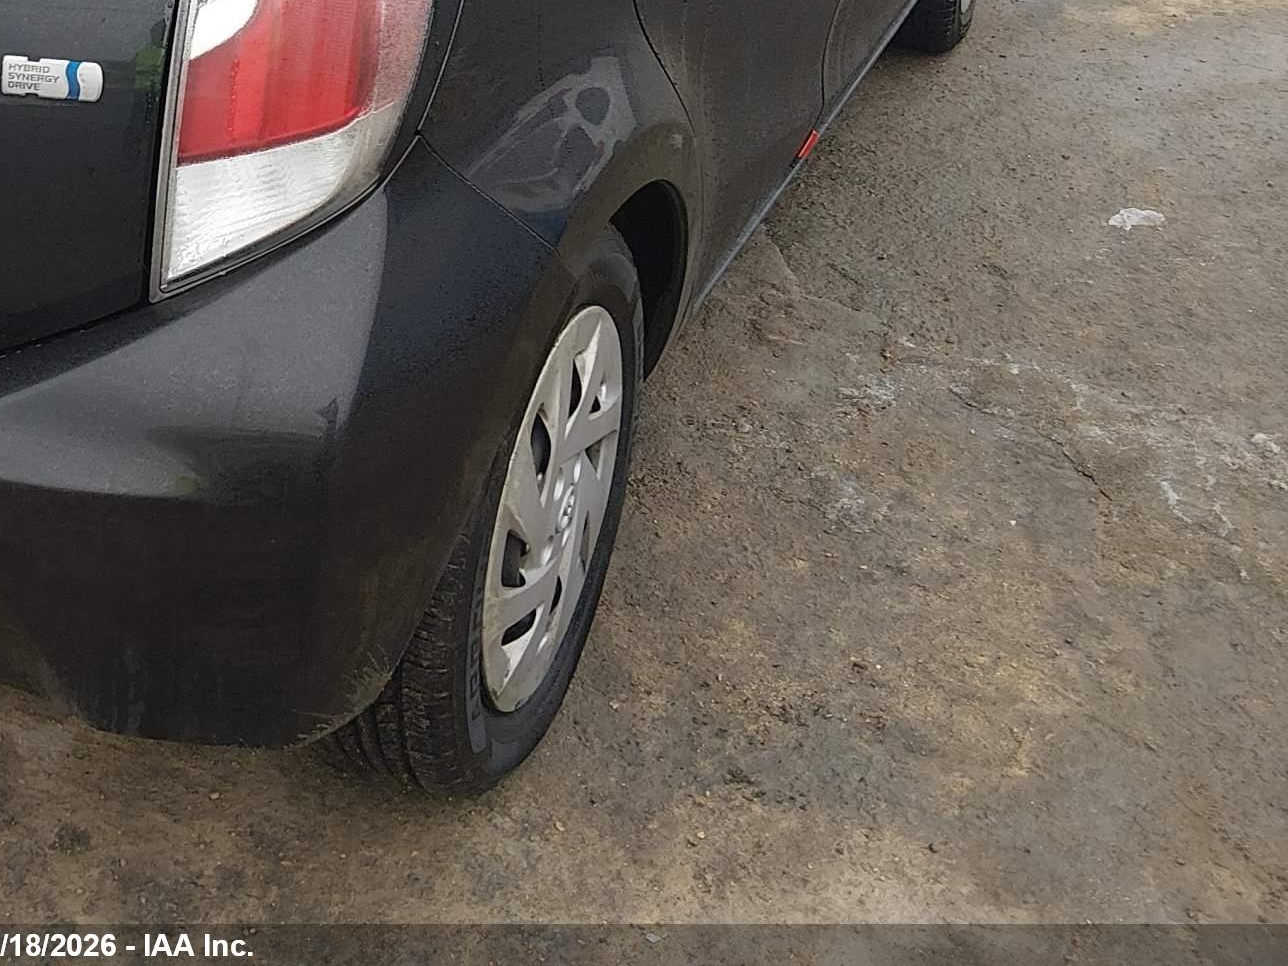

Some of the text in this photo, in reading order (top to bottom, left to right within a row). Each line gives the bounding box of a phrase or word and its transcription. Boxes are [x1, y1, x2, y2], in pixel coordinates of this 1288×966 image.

[8, 63, 51, 74] HYBRID
[8, 72, 60, 84] SYNERGY
[7, 81, 41, 91] DRIVE
